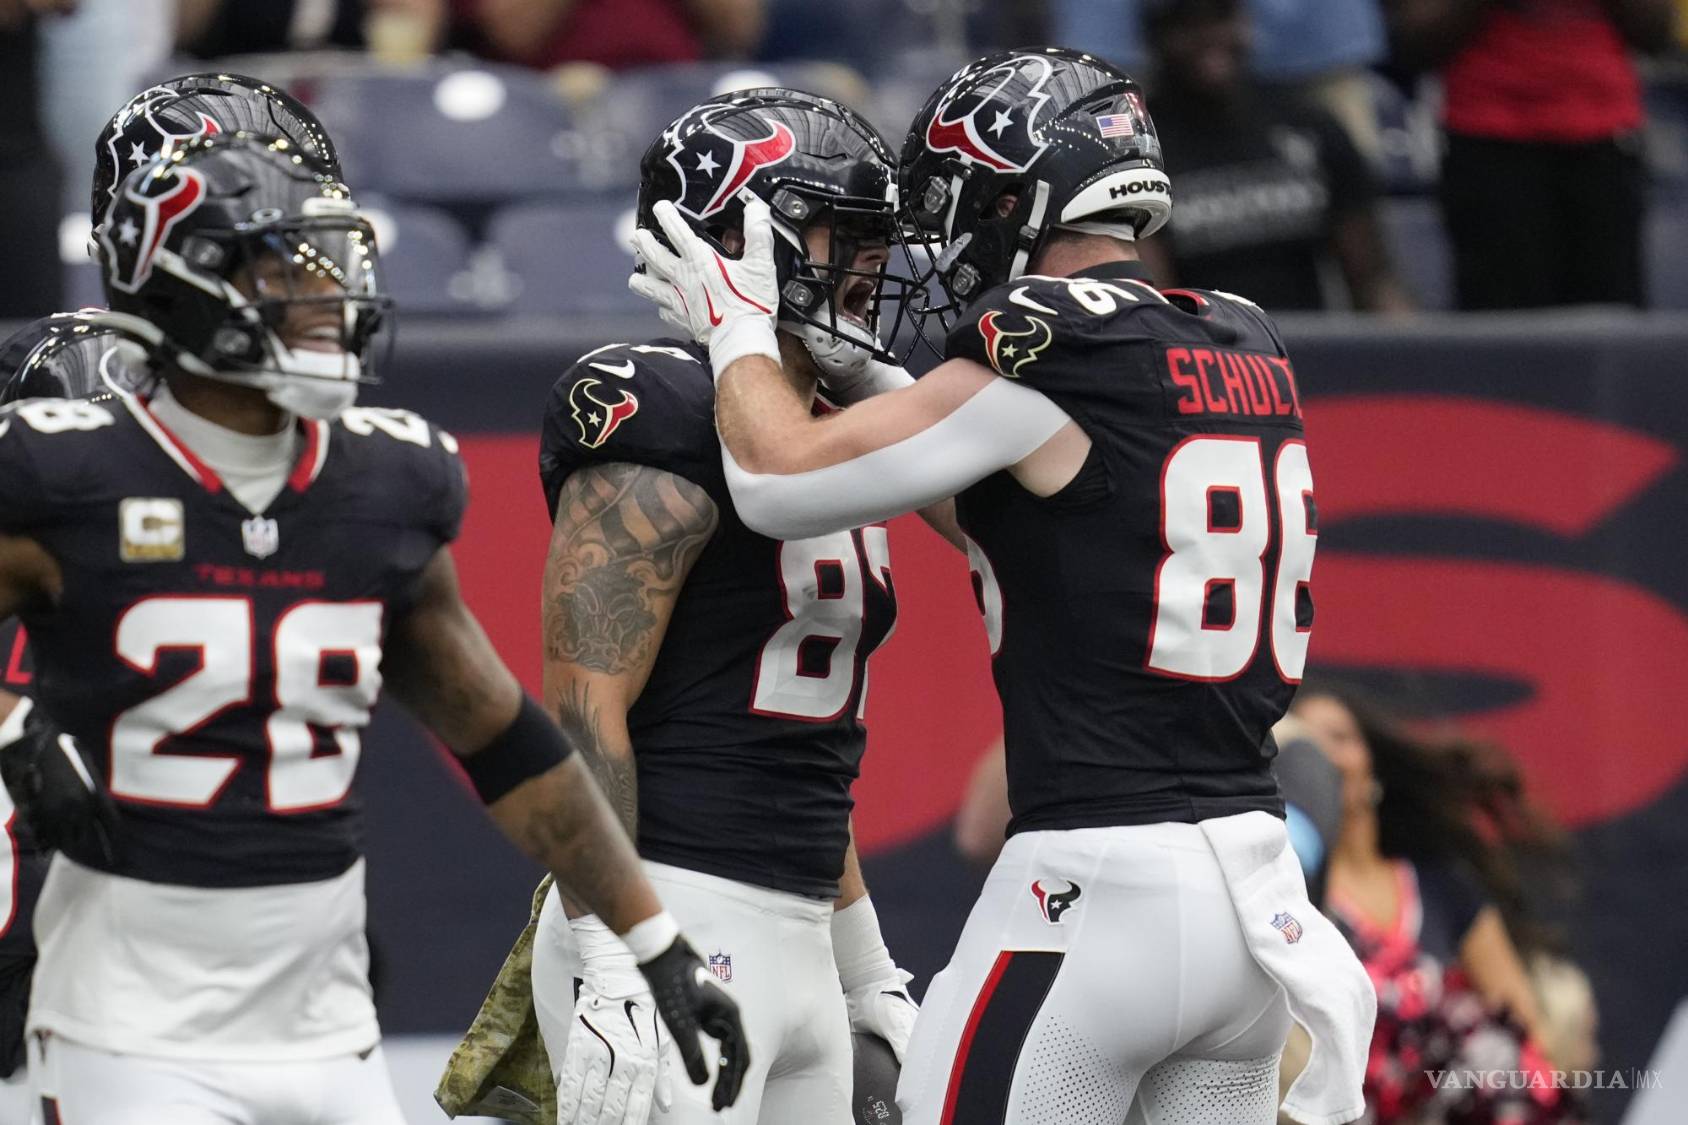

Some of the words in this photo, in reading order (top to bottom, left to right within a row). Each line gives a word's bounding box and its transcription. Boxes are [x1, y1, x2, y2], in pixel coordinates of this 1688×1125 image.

[1109, 180, 1172, 200] HOUST
[1167, 347, 1303, 418] SCHULT
[122, 498, 182, 546] C
[193, 563, 325, 590] TEXANS
[108, 594, 383, 815] 28
